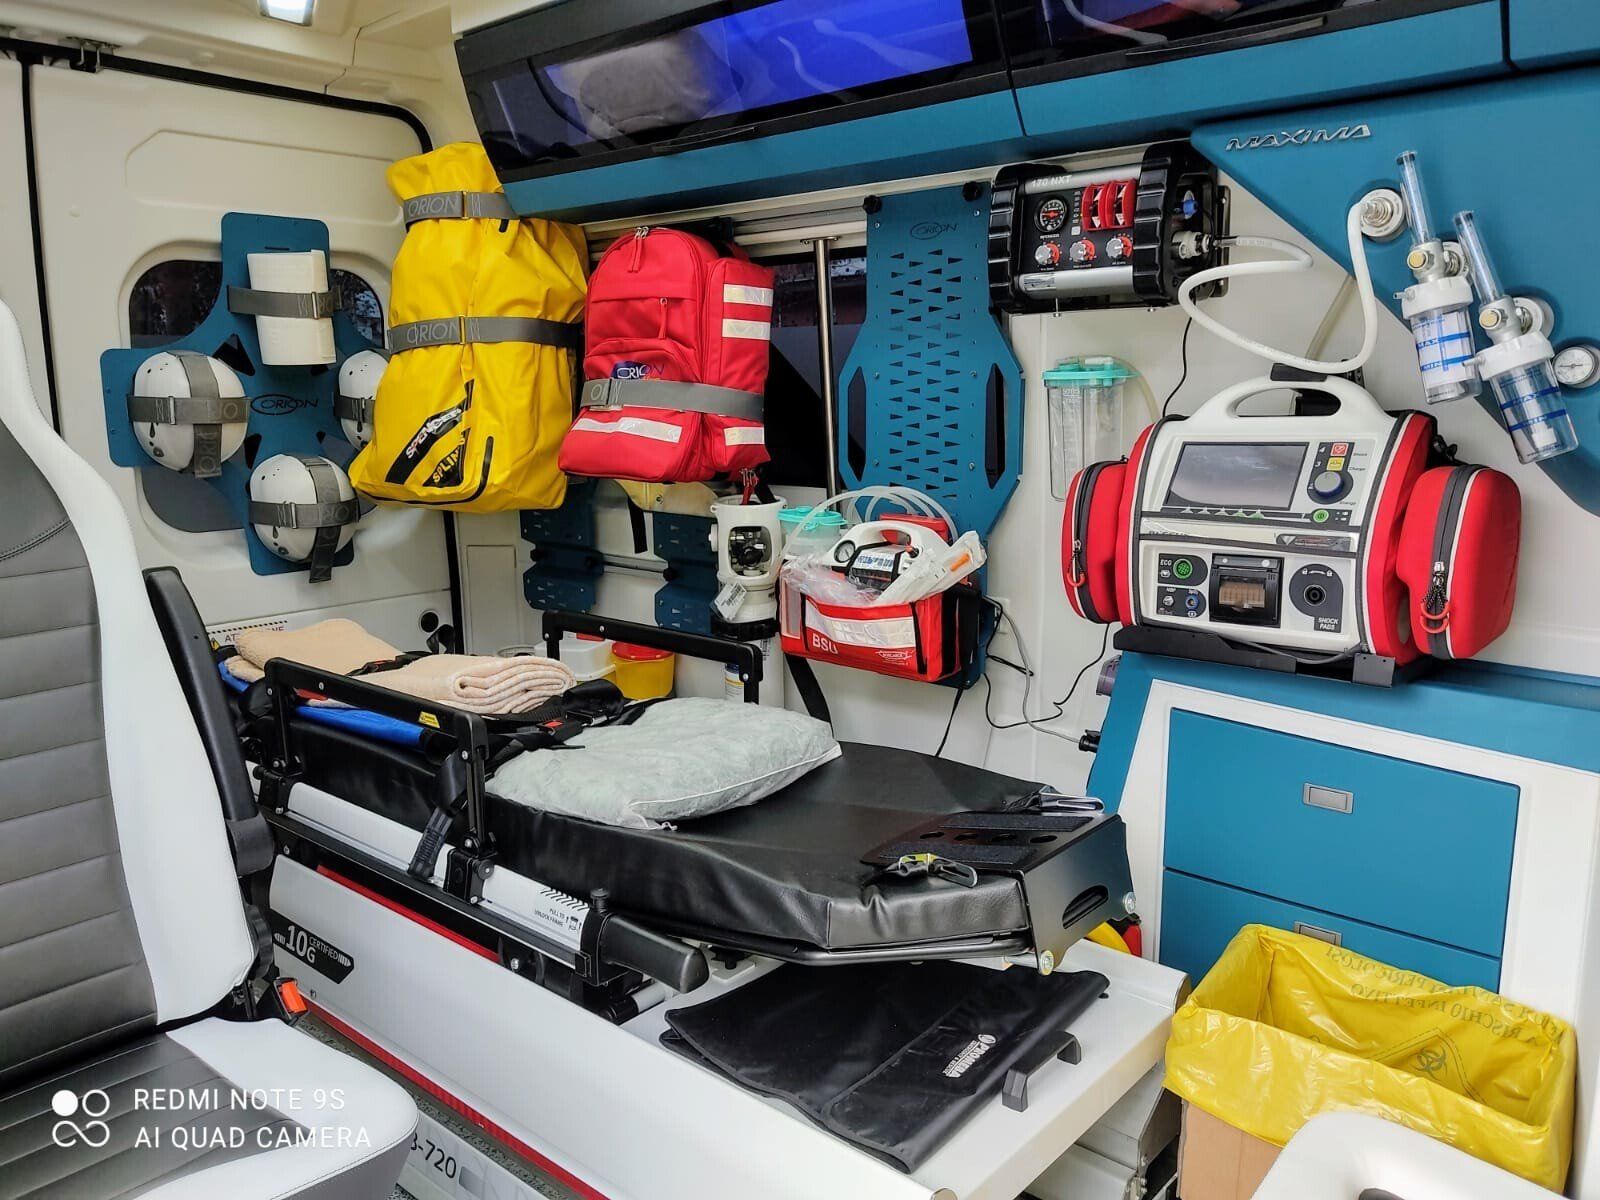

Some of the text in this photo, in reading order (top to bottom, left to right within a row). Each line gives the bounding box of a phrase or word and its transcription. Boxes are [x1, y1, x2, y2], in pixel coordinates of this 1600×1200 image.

[1225, 124, 1371, 151] MAXIMA
[407, 194, 458, 217] ORION
[406, 321, 458, 345] ORION
[616, 364, 665, 379] ORION
[260, 399, 318, 410] ORION
[1318, 617, 1339, 625] SHOCK
[308, 936, 339, 960] CERTIFIED
